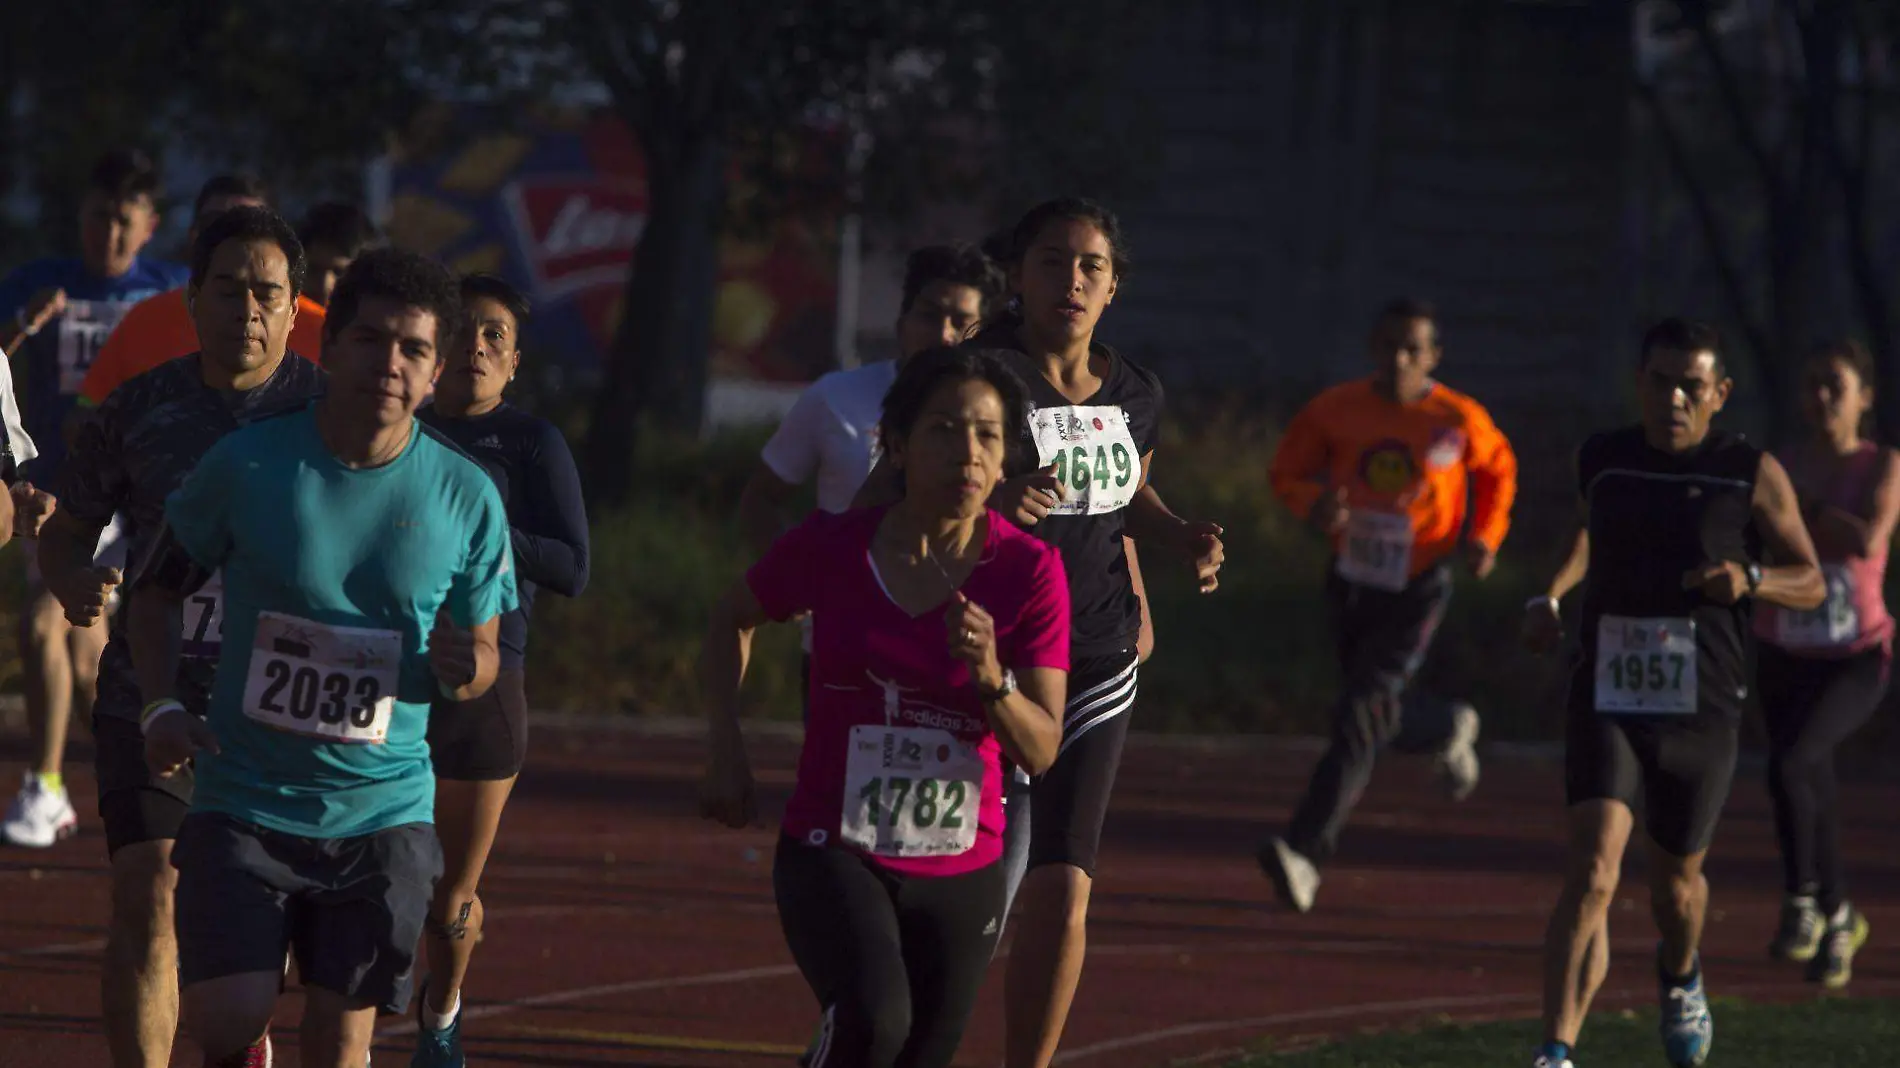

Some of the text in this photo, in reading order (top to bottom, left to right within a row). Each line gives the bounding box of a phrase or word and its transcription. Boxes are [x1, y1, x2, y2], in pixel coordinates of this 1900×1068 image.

[1052, 442, 1132, 491] 1649
[258, 659, 380, 729] 2033
[1608, 653, 1685, 692] 1957
[902, 709, 962, 731] adidas
[859, 776, 966, 829] 1782
